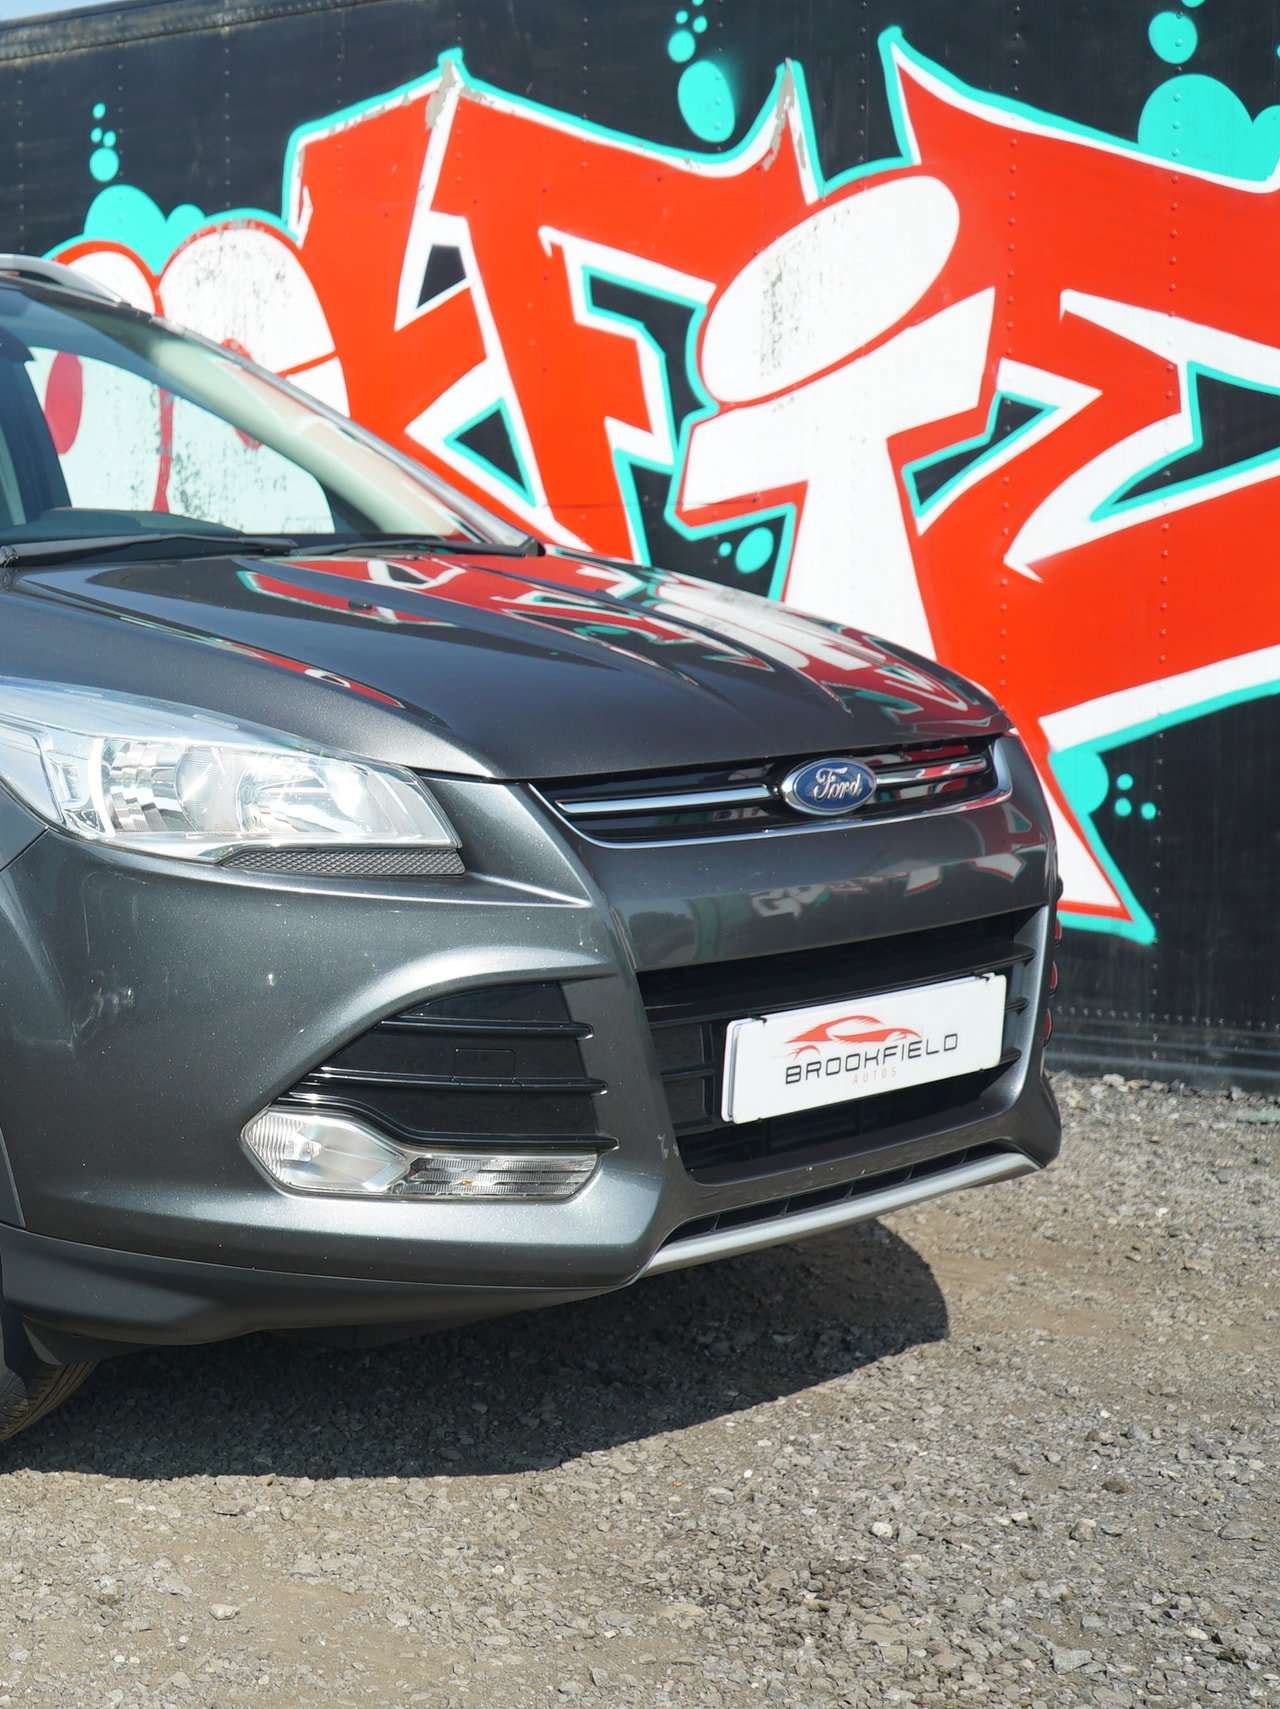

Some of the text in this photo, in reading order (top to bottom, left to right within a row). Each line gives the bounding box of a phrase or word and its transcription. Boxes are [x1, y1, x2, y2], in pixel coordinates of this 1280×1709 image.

[812, 766, 863, 801] Ford
[785, 1033, 958, 1085] BROOKFIELD
[851, 1069, 897, 1085] AUTOS
